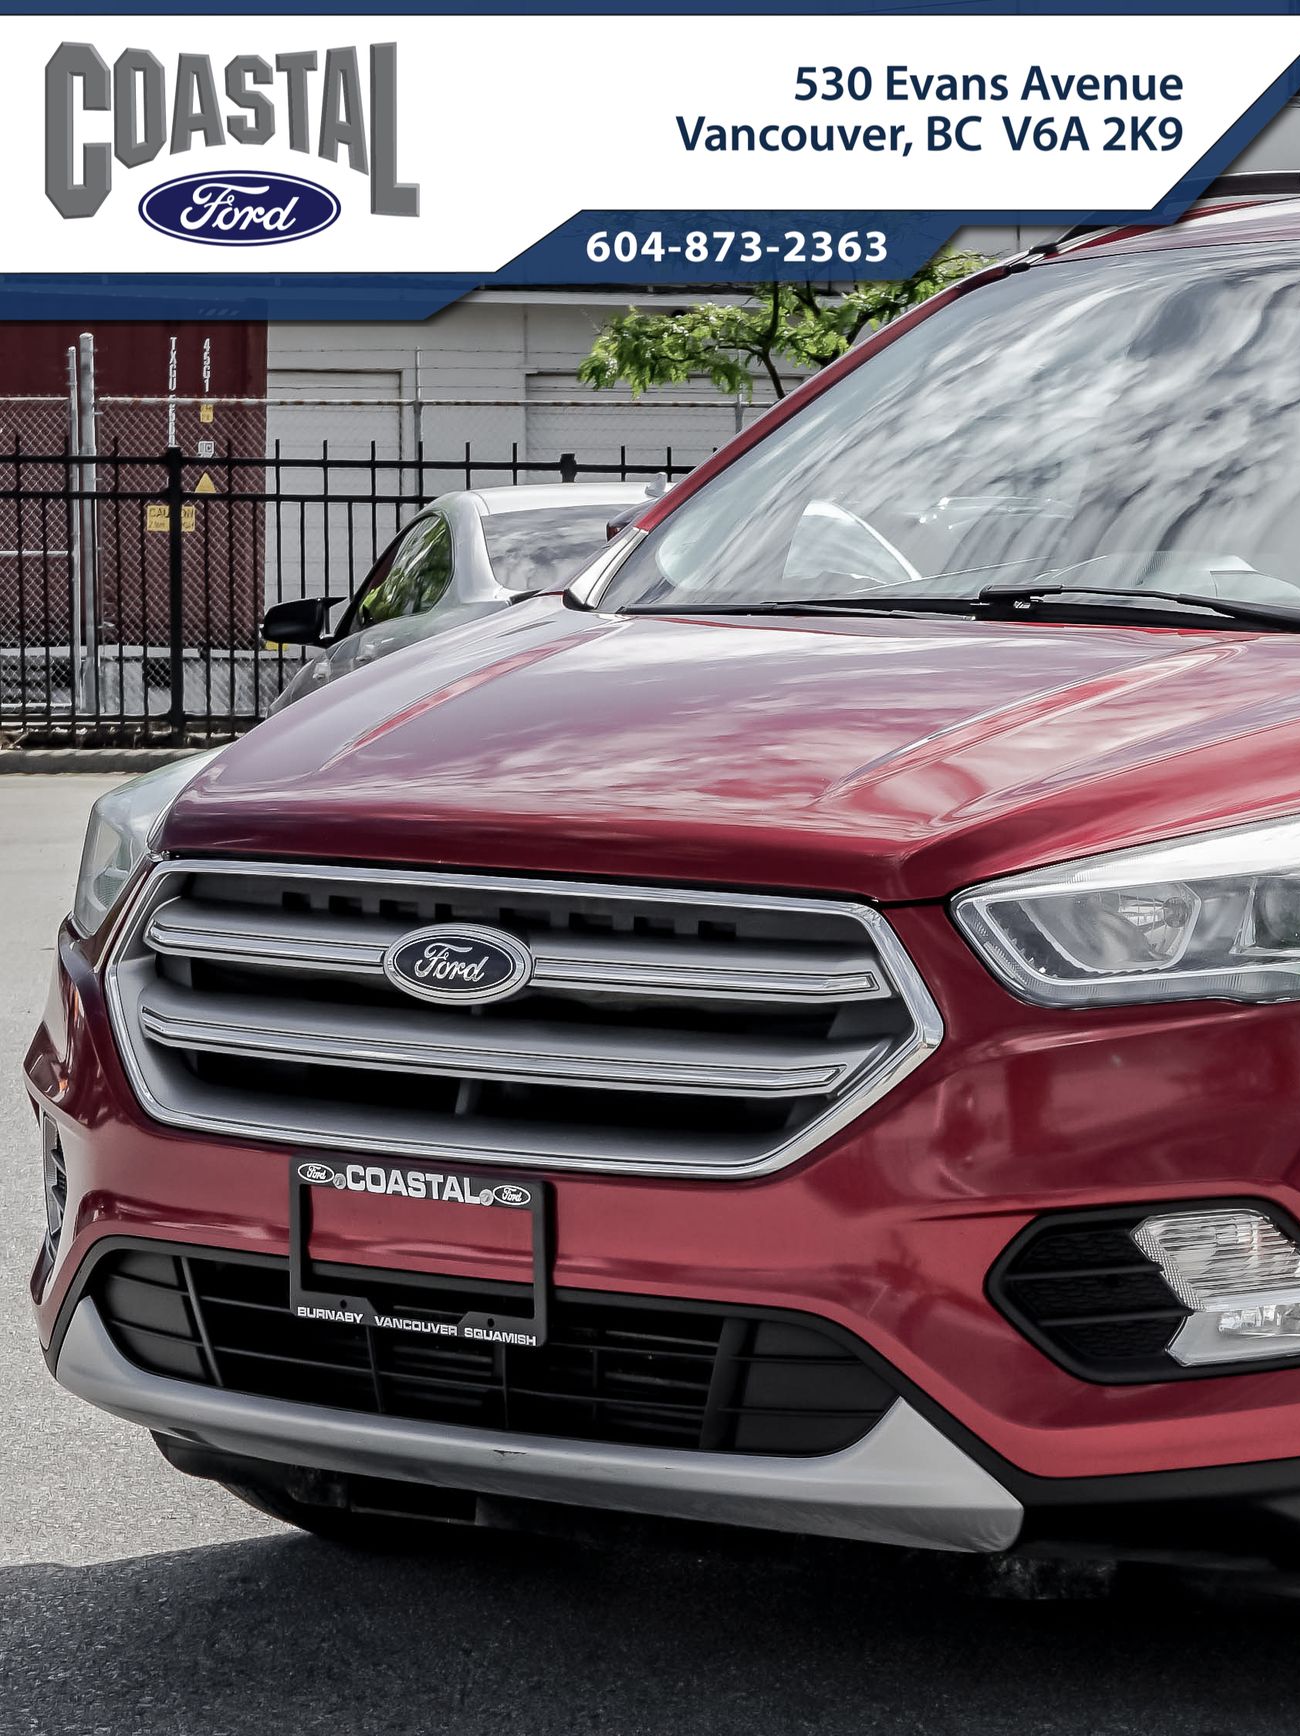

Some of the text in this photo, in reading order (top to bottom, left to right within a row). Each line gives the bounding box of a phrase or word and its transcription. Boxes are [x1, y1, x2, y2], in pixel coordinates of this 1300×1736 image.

[414, 942, 490, 982] Ford
[306, 1164, 524, 1205] Ford COASTAL Ford
[297, 1306, 537, 1347] BURNABY VANCOUVER SQUAMISH
